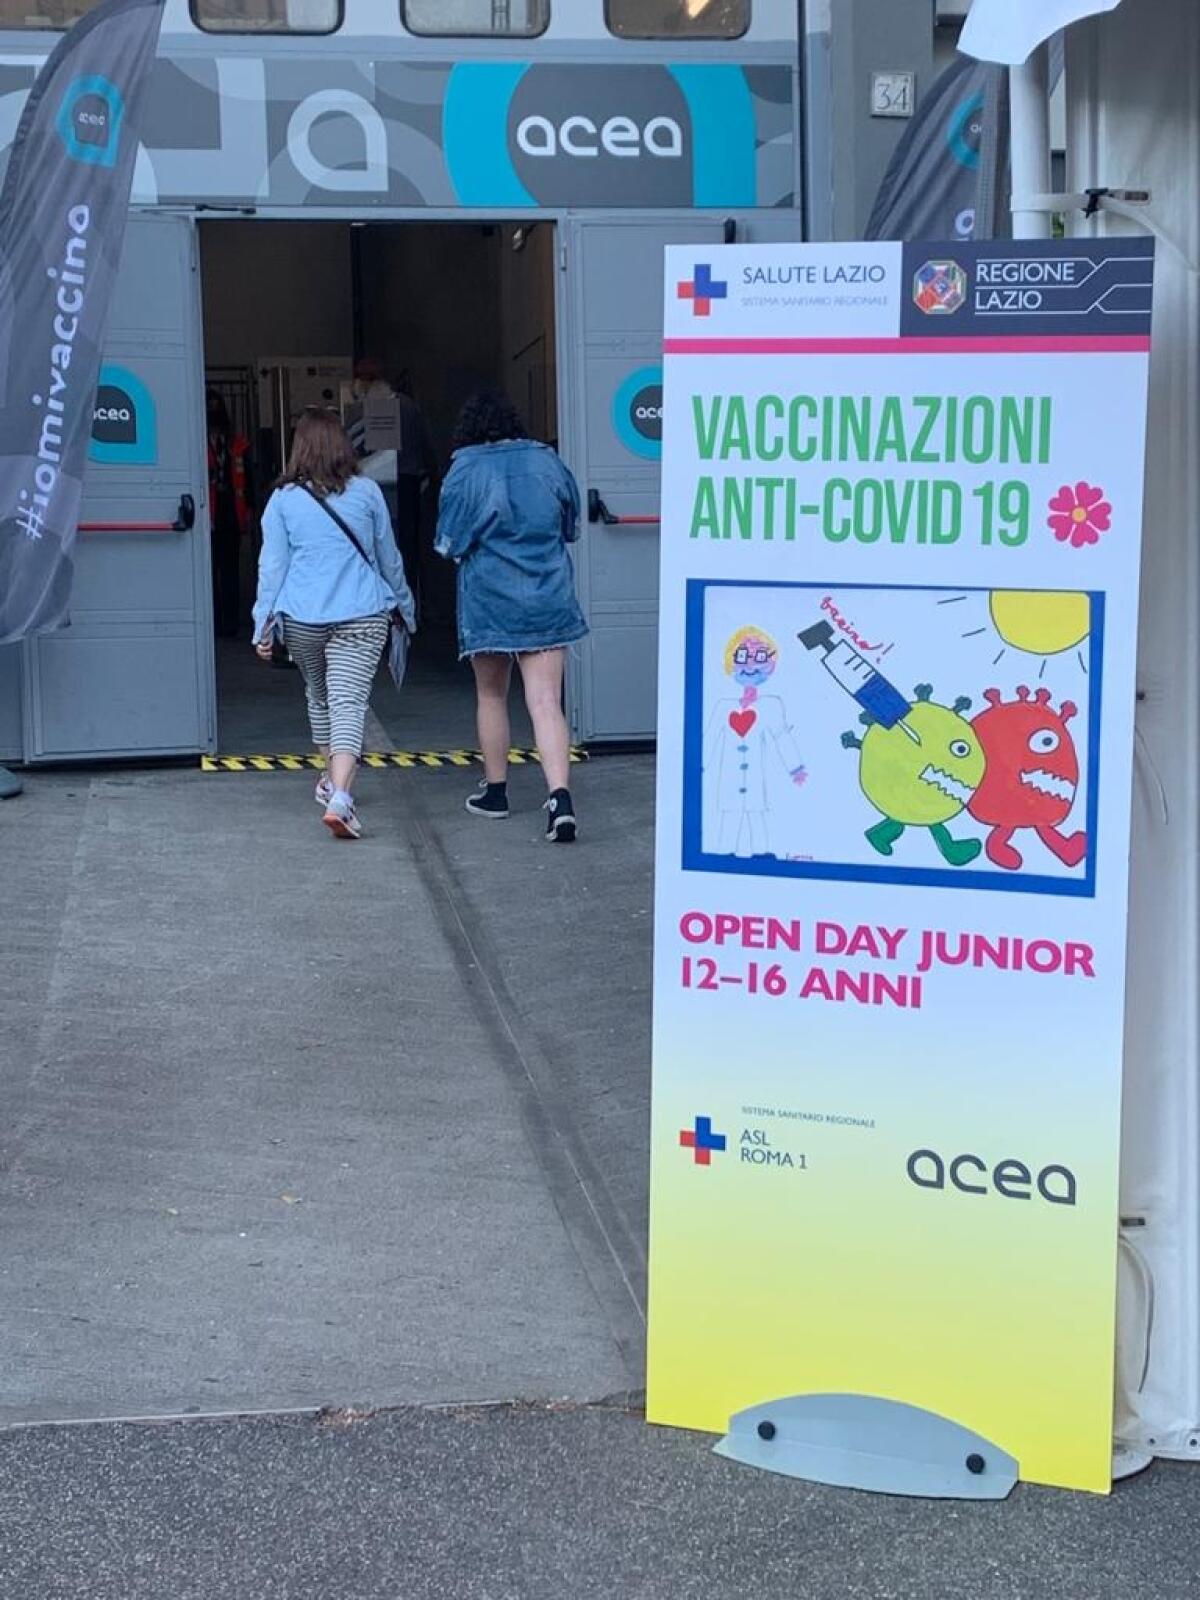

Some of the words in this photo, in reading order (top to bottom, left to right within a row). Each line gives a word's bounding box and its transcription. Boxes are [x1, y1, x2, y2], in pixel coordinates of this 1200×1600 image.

[877, 77, 911, 111] 34
[516, 115, 682, 156] acea
[742, 265, 817, 284] SALUTE
[823, 264, 887, 284] LAZIO
[975, 261, 1076, 283] REGIONE
[974, 290, 1043, 310] LAZIO
[15, 203, 90, 541] #iomivaccino
[93, 407, 131, 421] cea
[691, 394, 1053, 464] VACCINAZIONI
[689, 475, 963, 545] ANTI-COVID
[971, 480, 1030, 547] 19
[679, 911, 802, 952] OPEN
[815, 921, 908, 959] DAY
[916, 930, 1097, 977] JUNIOR
[800, 967, 923, 1009] ANNI
[741, 1105, 776, 1117] SISTEMA
[778, 1109, 824, 1122] SANITARIO
[826, 1114, 877, 1129] REGIONALE
[740, 1128, 771, 1147] ASL
[740, 1147, 795, 1168] ROMA
[799, 1154, 808, 1170] 1
[906, 1149, 1077, 1206] acea
